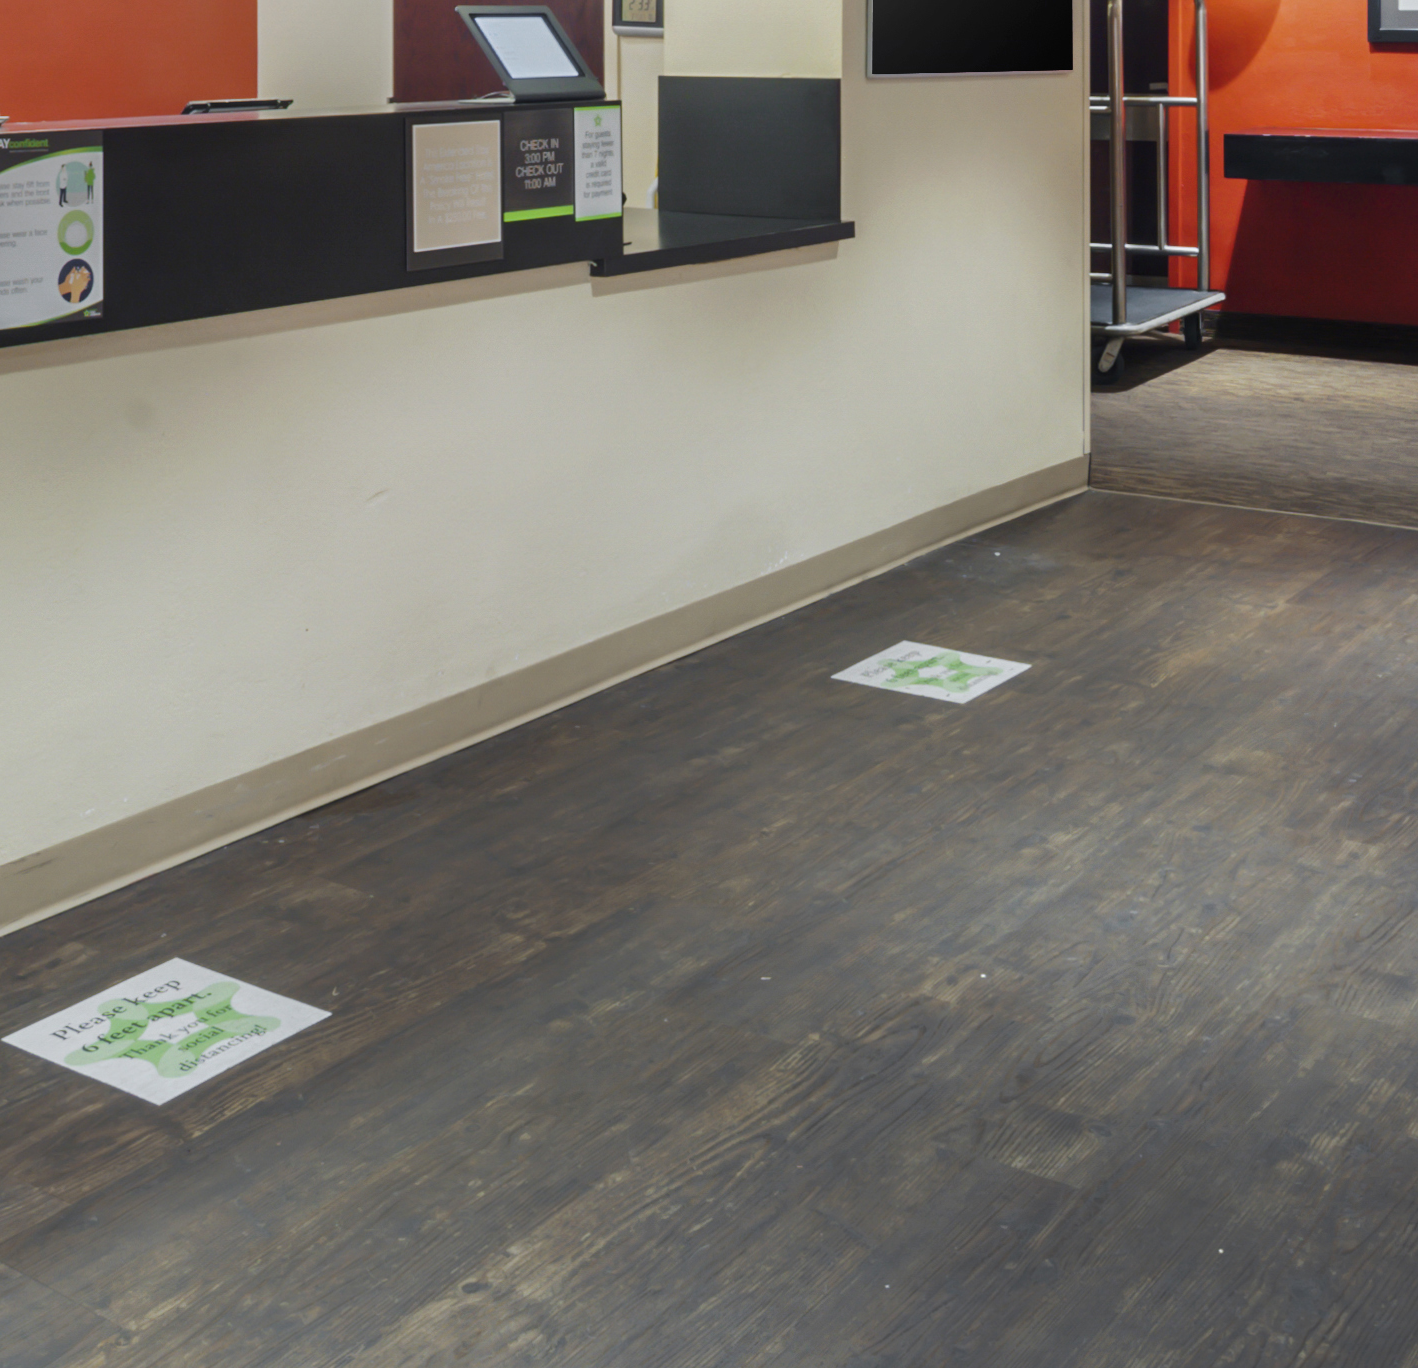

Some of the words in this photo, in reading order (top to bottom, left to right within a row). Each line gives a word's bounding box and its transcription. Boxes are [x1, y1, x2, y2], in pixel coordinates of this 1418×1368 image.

[520, 138, 549, 151] CHECK
[550, 138, 559, 149] IN
[543, 151, 555, 162] PM
[515, 165, 545, 178] CHECK
[546, 163, 564, 175] OUT
[543, 176, 556, 188] AM
[49, 1003, 128, 1041] Please
[121, 979, 182, 1006] keep
[82, 1042, 99, 1054] 6
[97, 1019, 147, 1046] feet
[146, 991, 212, 1023] apart.
[118, 1032, 176, 1061] Thank
[179, 1014, 209, 1036] you
[207, 1003, 233, 1021] for
[178, 1026, 225, 1052] social
[178, 1023, 268, 1073] distancing!
